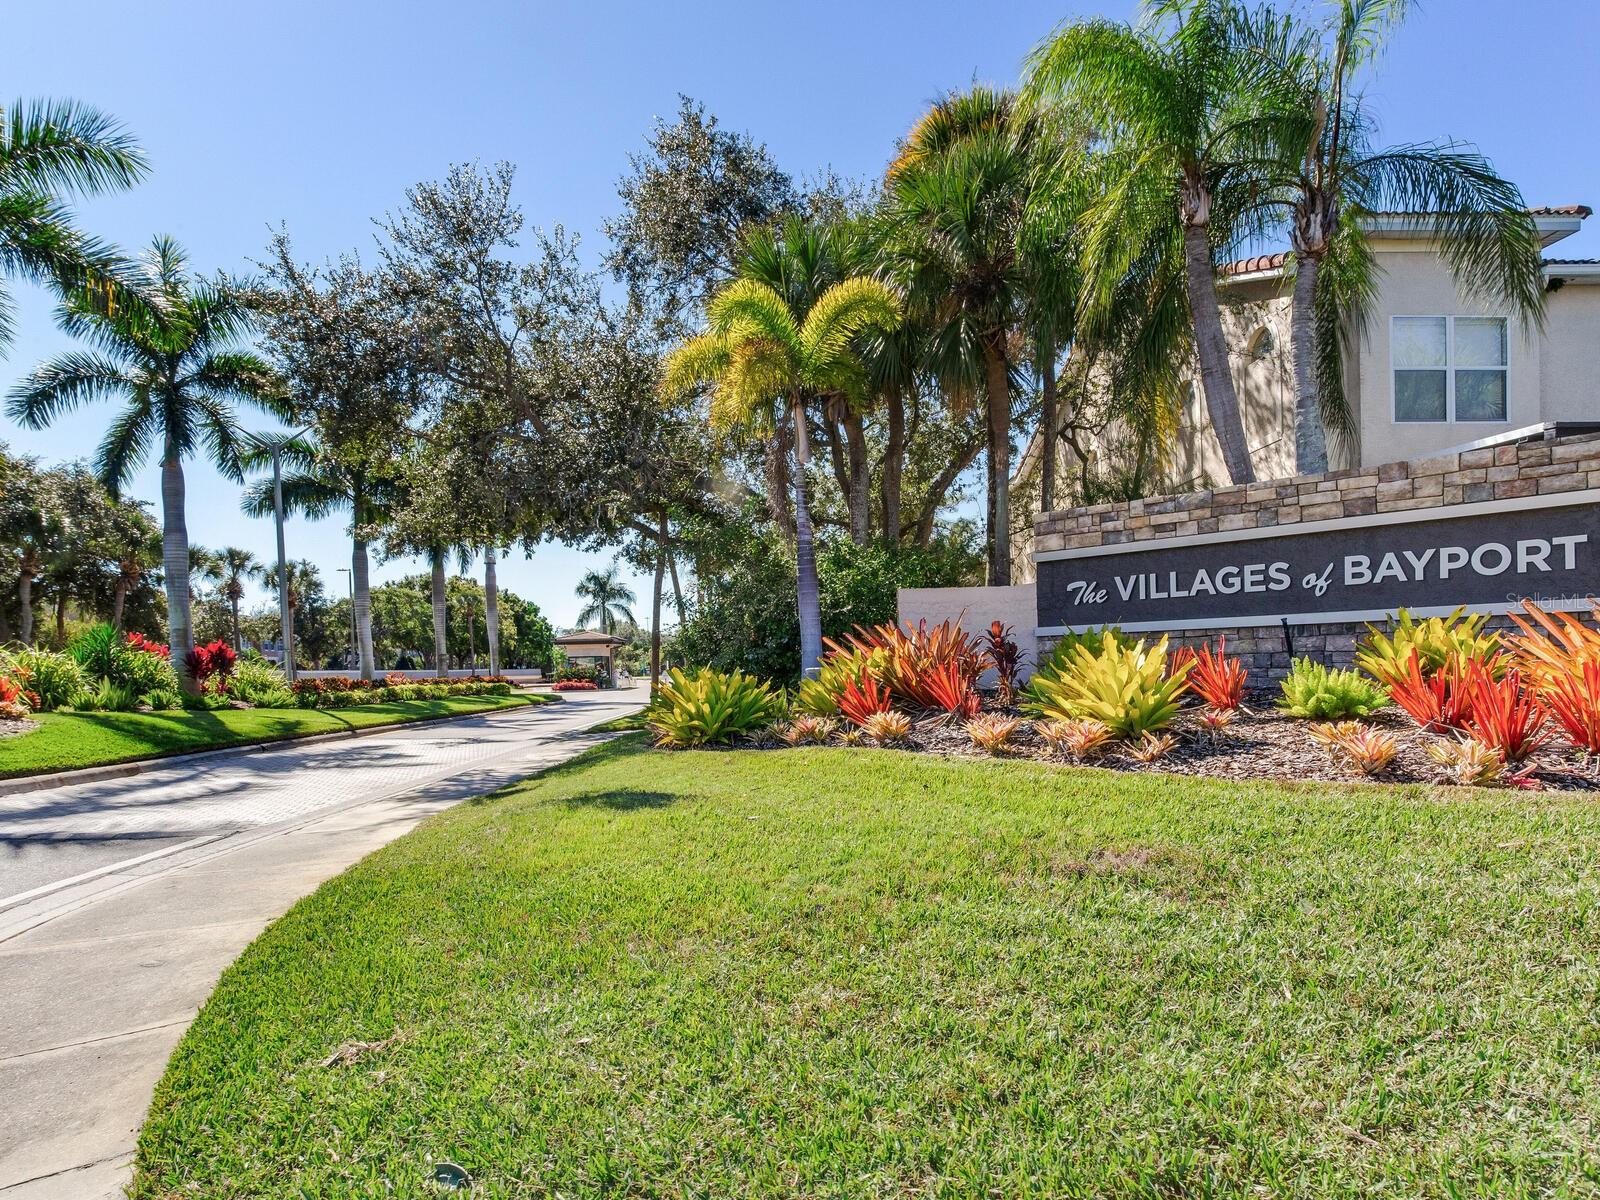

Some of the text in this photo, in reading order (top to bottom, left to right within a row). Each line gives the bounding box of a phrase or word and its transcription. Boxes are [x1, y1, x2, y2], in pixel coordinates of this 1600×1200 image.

[1067, 534, 1587, 605] The VILLAGES of BAYPORT
